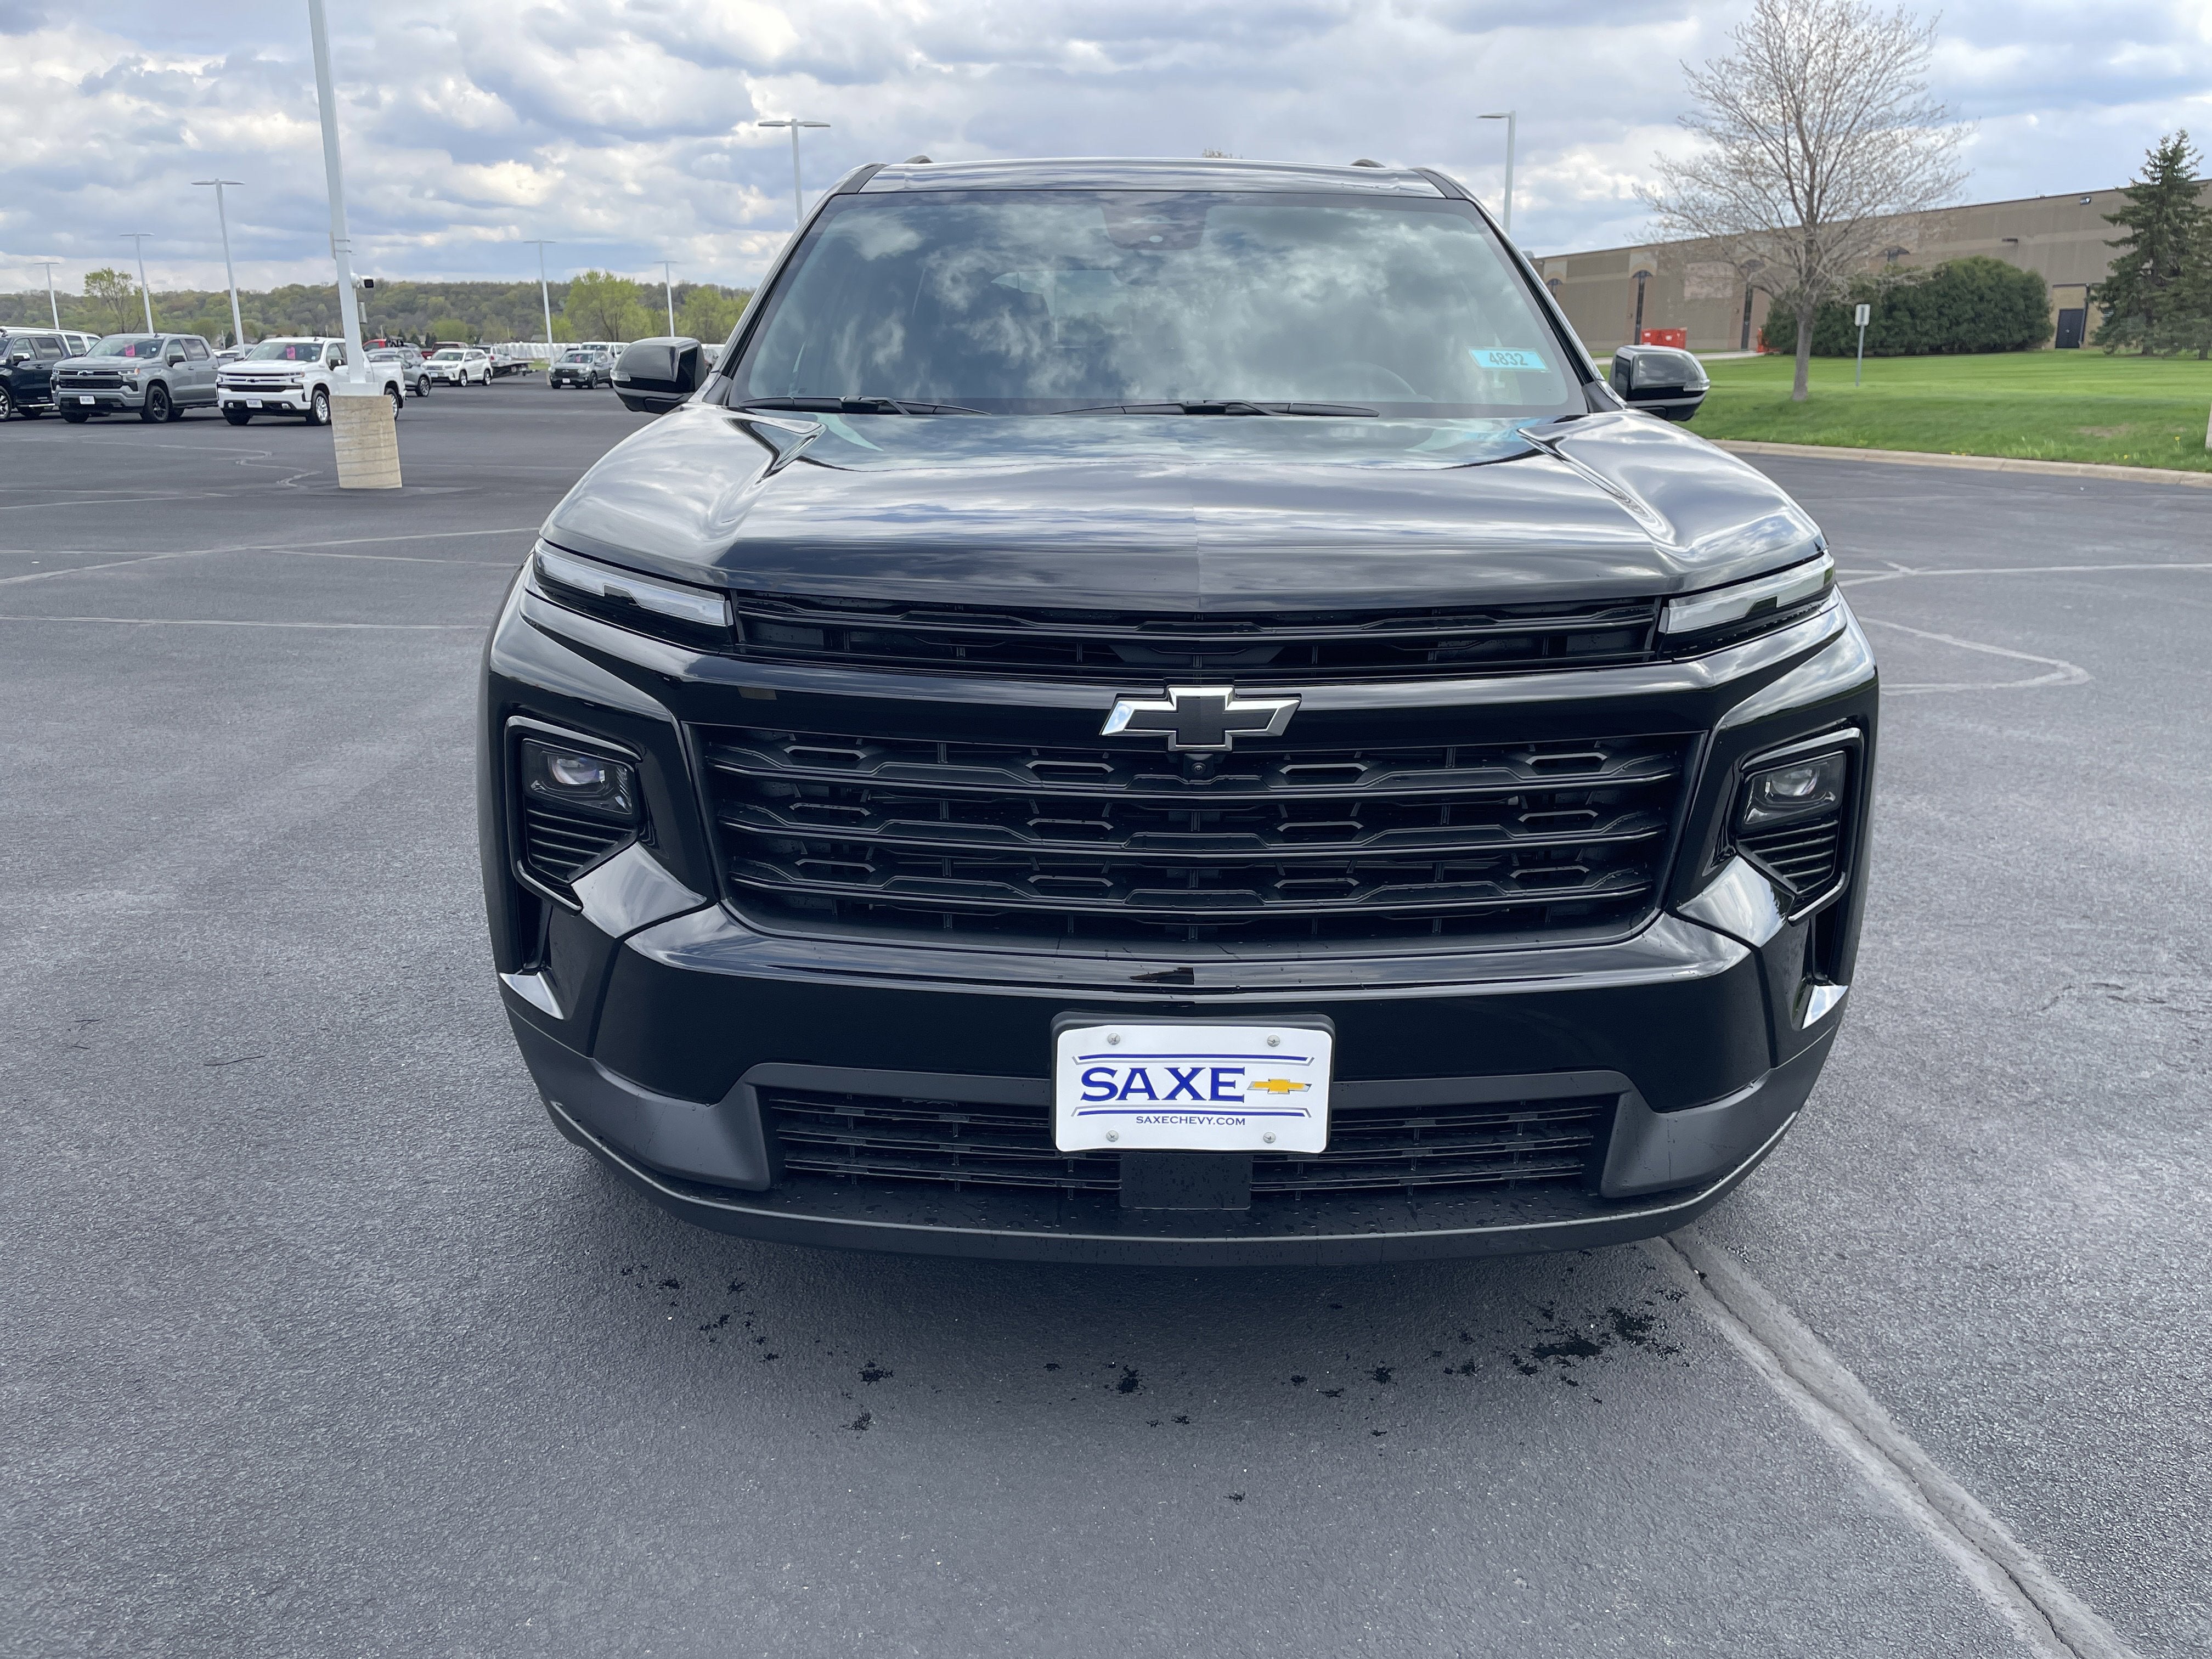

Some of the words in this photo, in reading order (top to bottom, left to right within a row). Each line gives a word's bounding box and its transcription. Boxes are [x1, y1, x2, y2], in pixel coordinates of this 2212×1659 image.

[1489, 352, 1528, 365] 4832
[1080, 1066, 1245, 1103] SAXE
[1136, 1116, 1246, 1126] SAXECHEVY.COM
